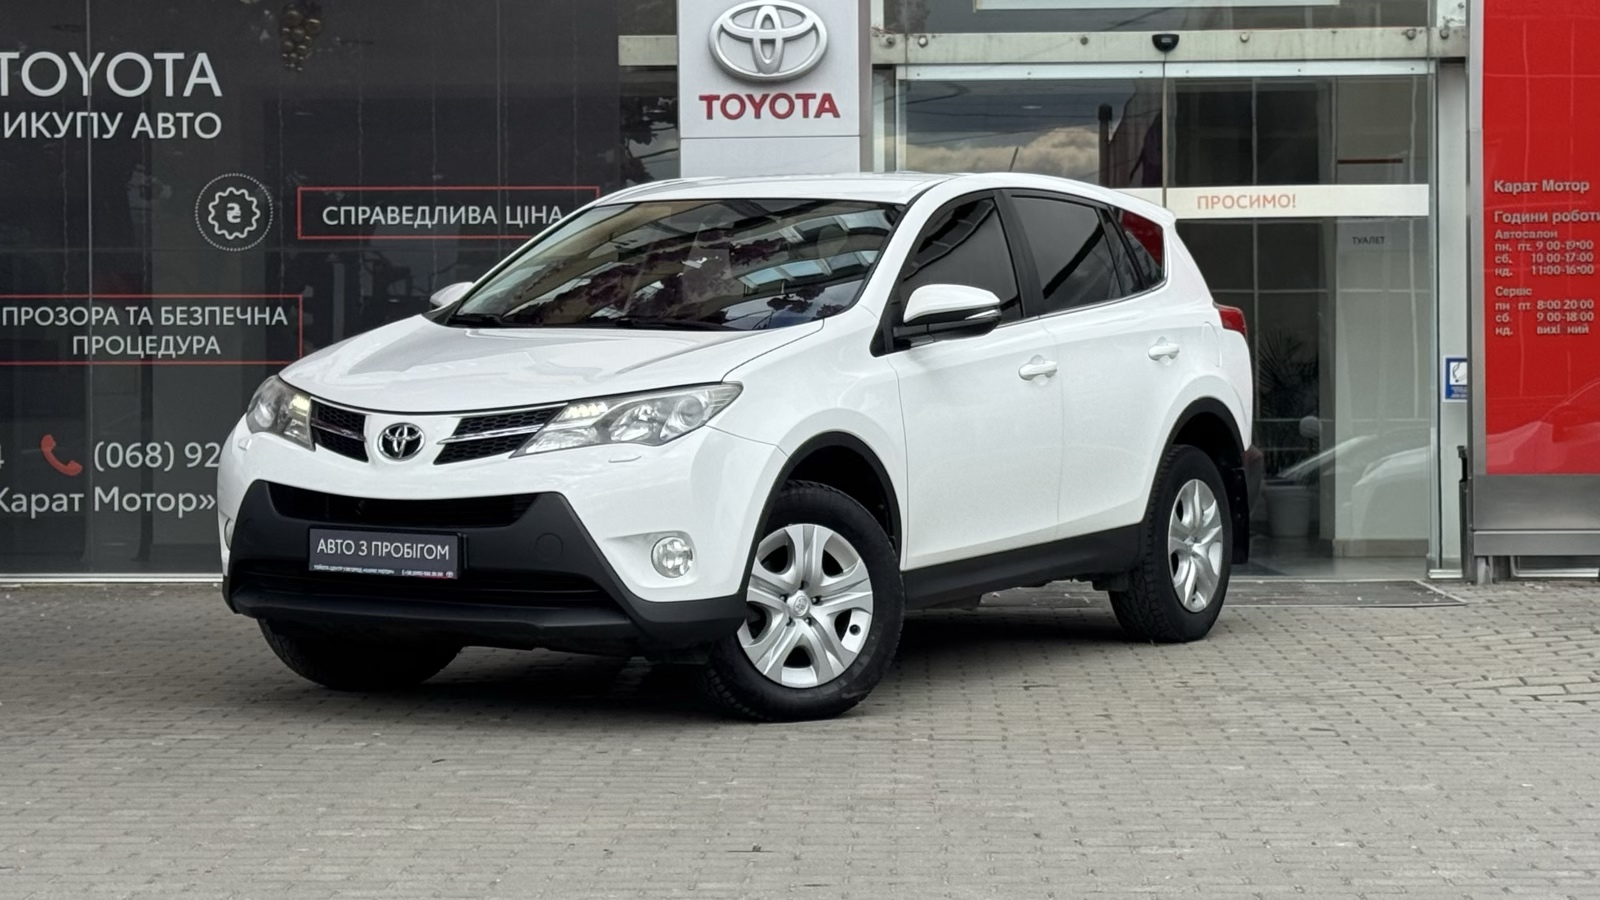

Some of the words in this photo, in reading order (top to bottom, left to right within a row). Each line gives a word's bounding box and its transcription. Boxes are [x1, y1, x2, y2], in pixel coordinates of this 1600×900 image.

[0, 51, 223, 97] TOYOTA
[699, 93, 841, 120] TOYOTA
[131, 111, 223, 139] АВТО
[1494, 180, 1539, 195] Карат
[1541, 179, 1590, 194] Мотор
[1196, 193, 1297, 210] ПРОСИМО!
[322, 205, 498, 227] СПРАВЕДЛИВА
[505, 205, 562, 229] ЦІНА
[1494, 210, 1548, 225] Години
[1352, 236, 1385, 245] ТУАЛЕТ
[1494, 229, 1558, 239] Автосалон
[1495, 285, 1532, 298] Сервіс
[1, 306, 119, 327] ПРОЗОРА
[125, 306, 154, 327] ТА
[160, 306, 288, 327] БЕЗПЕЧНА
[72, 335, 222, 359] ПРОЦЕДУРА
[94, 441, 175, 472] (068)
[94, 486, 216, 519] Мотор»
[317, 538, 355, 555] АВТО
[358, 540, 368, 556] З
[371, 541, 450, 560] ПРОБІГОМ
